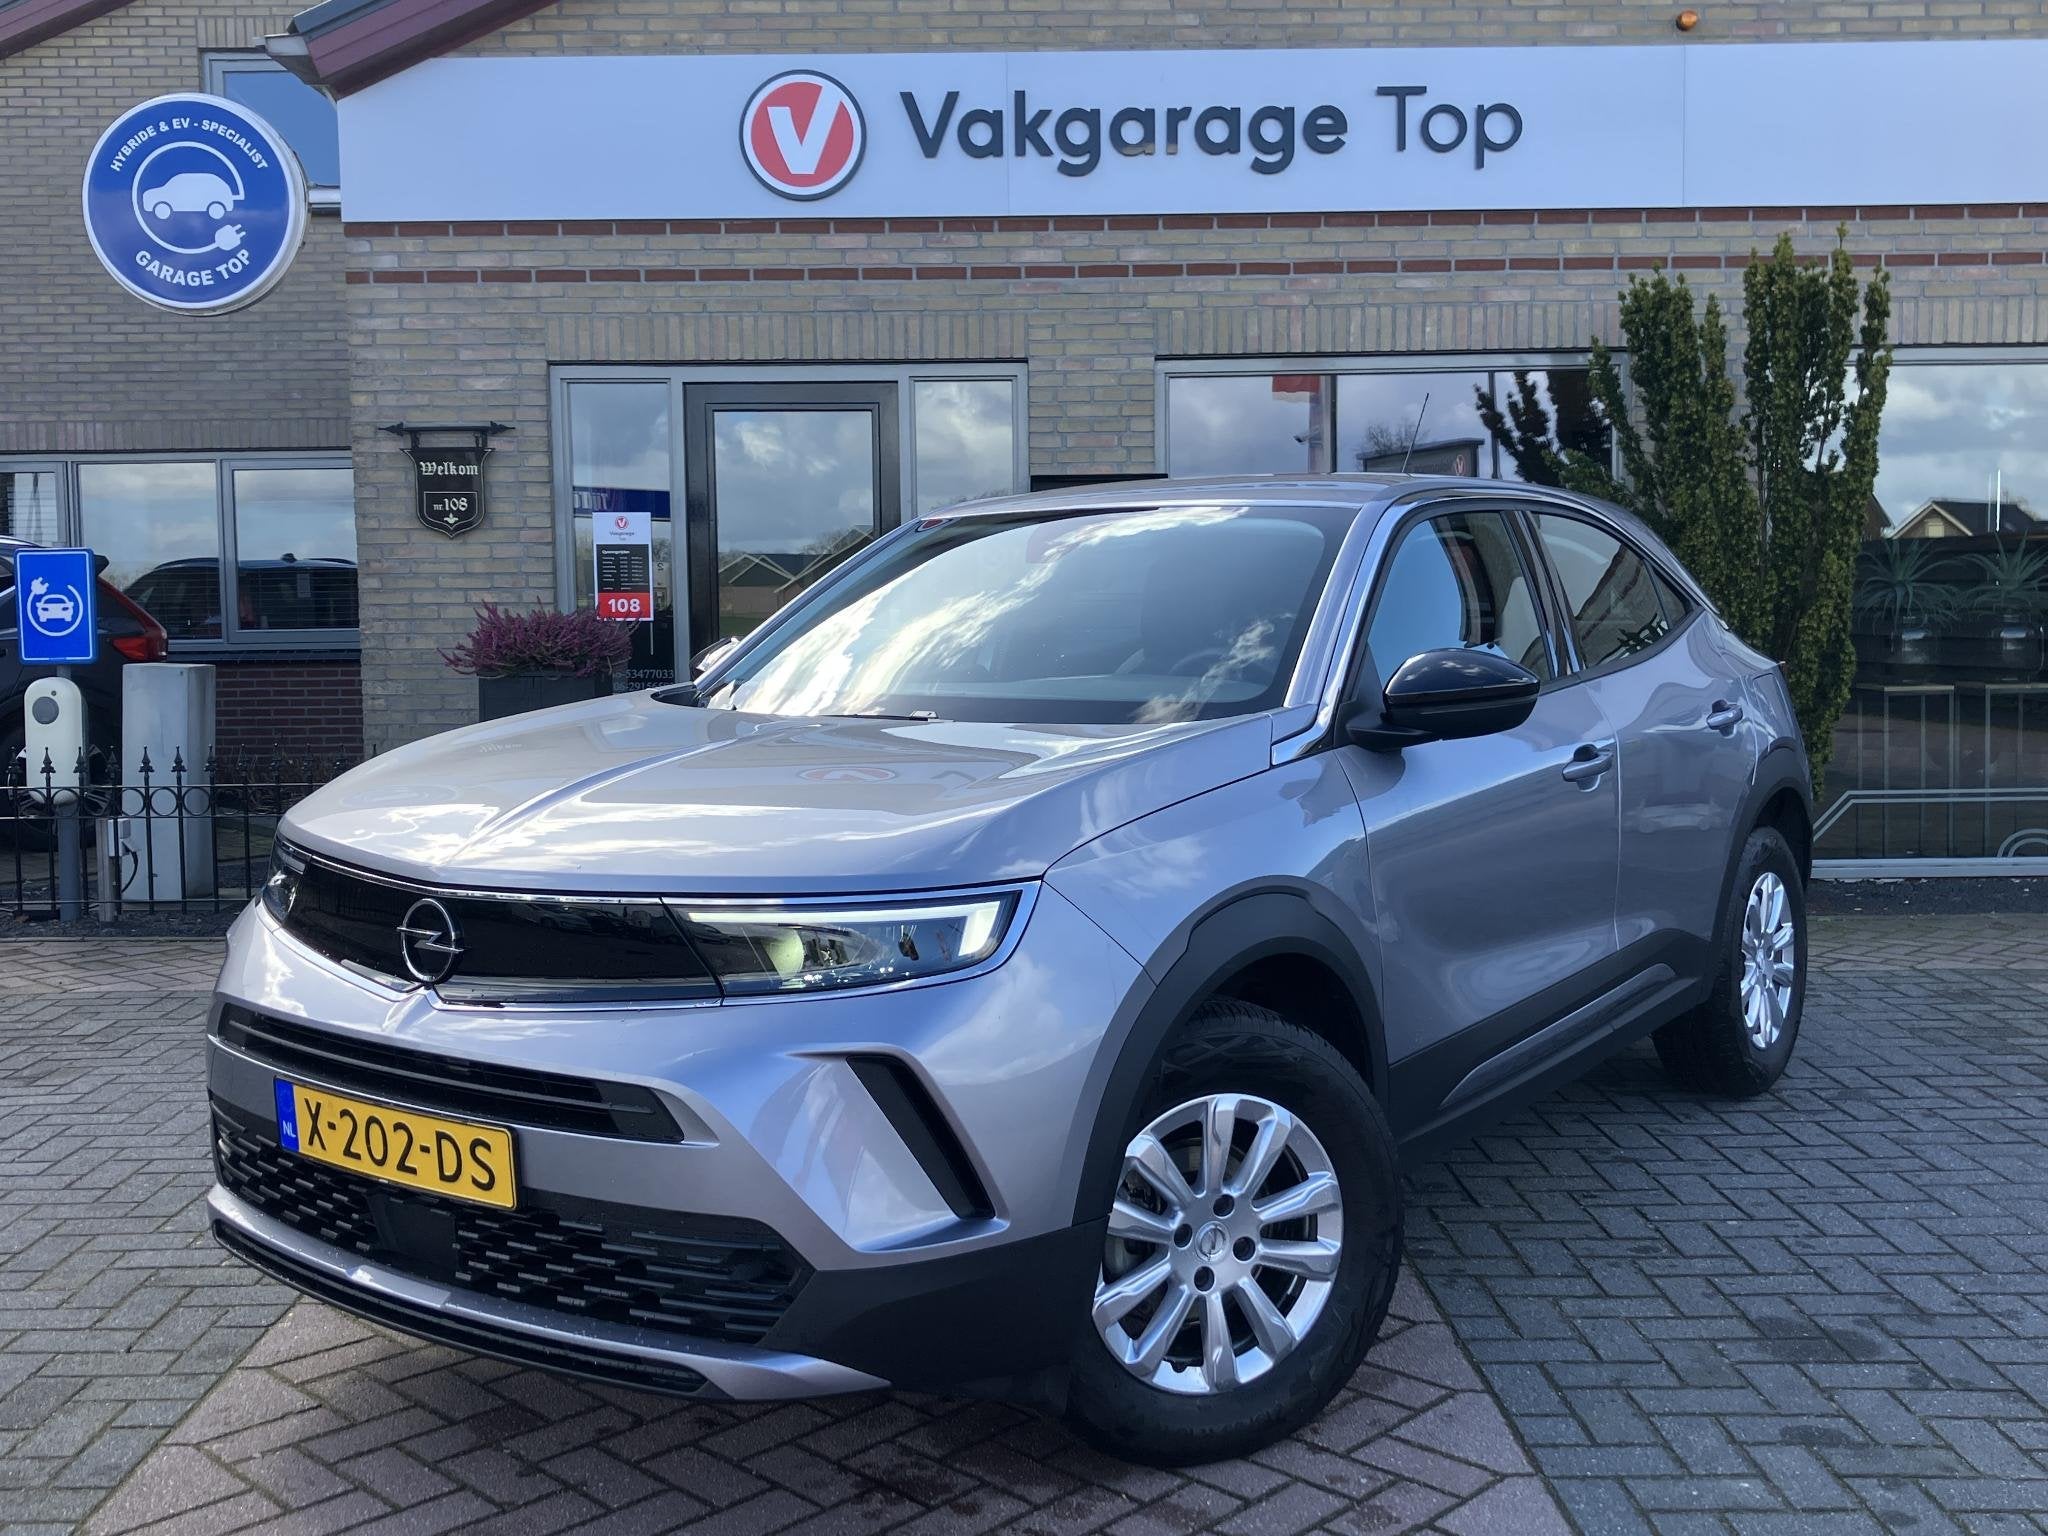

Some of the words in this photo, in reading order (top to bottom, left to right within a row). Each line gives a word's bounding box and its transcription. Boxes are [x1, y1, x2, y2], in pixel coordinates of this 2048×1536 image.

[109, 124, 157, 172] HYBRIDE
[158, 121, 170, 132] &
[172, 117, 190, 130] EV
[201, 118, 269, 170] SPECIALIST
[899, 89, 1348, 177] Vakgarage
[1375, 85, 1523, 171] Top
[134, 249, 215, 287] GARAGE
[215, 248, 251, 280] TOP
[419, 461, 479, 476] Welkom
[607, 598, 641, 613] 108
[282, 1119, 297, 1138] NL
[303, 1097, 496, 1192] X-202-DS
